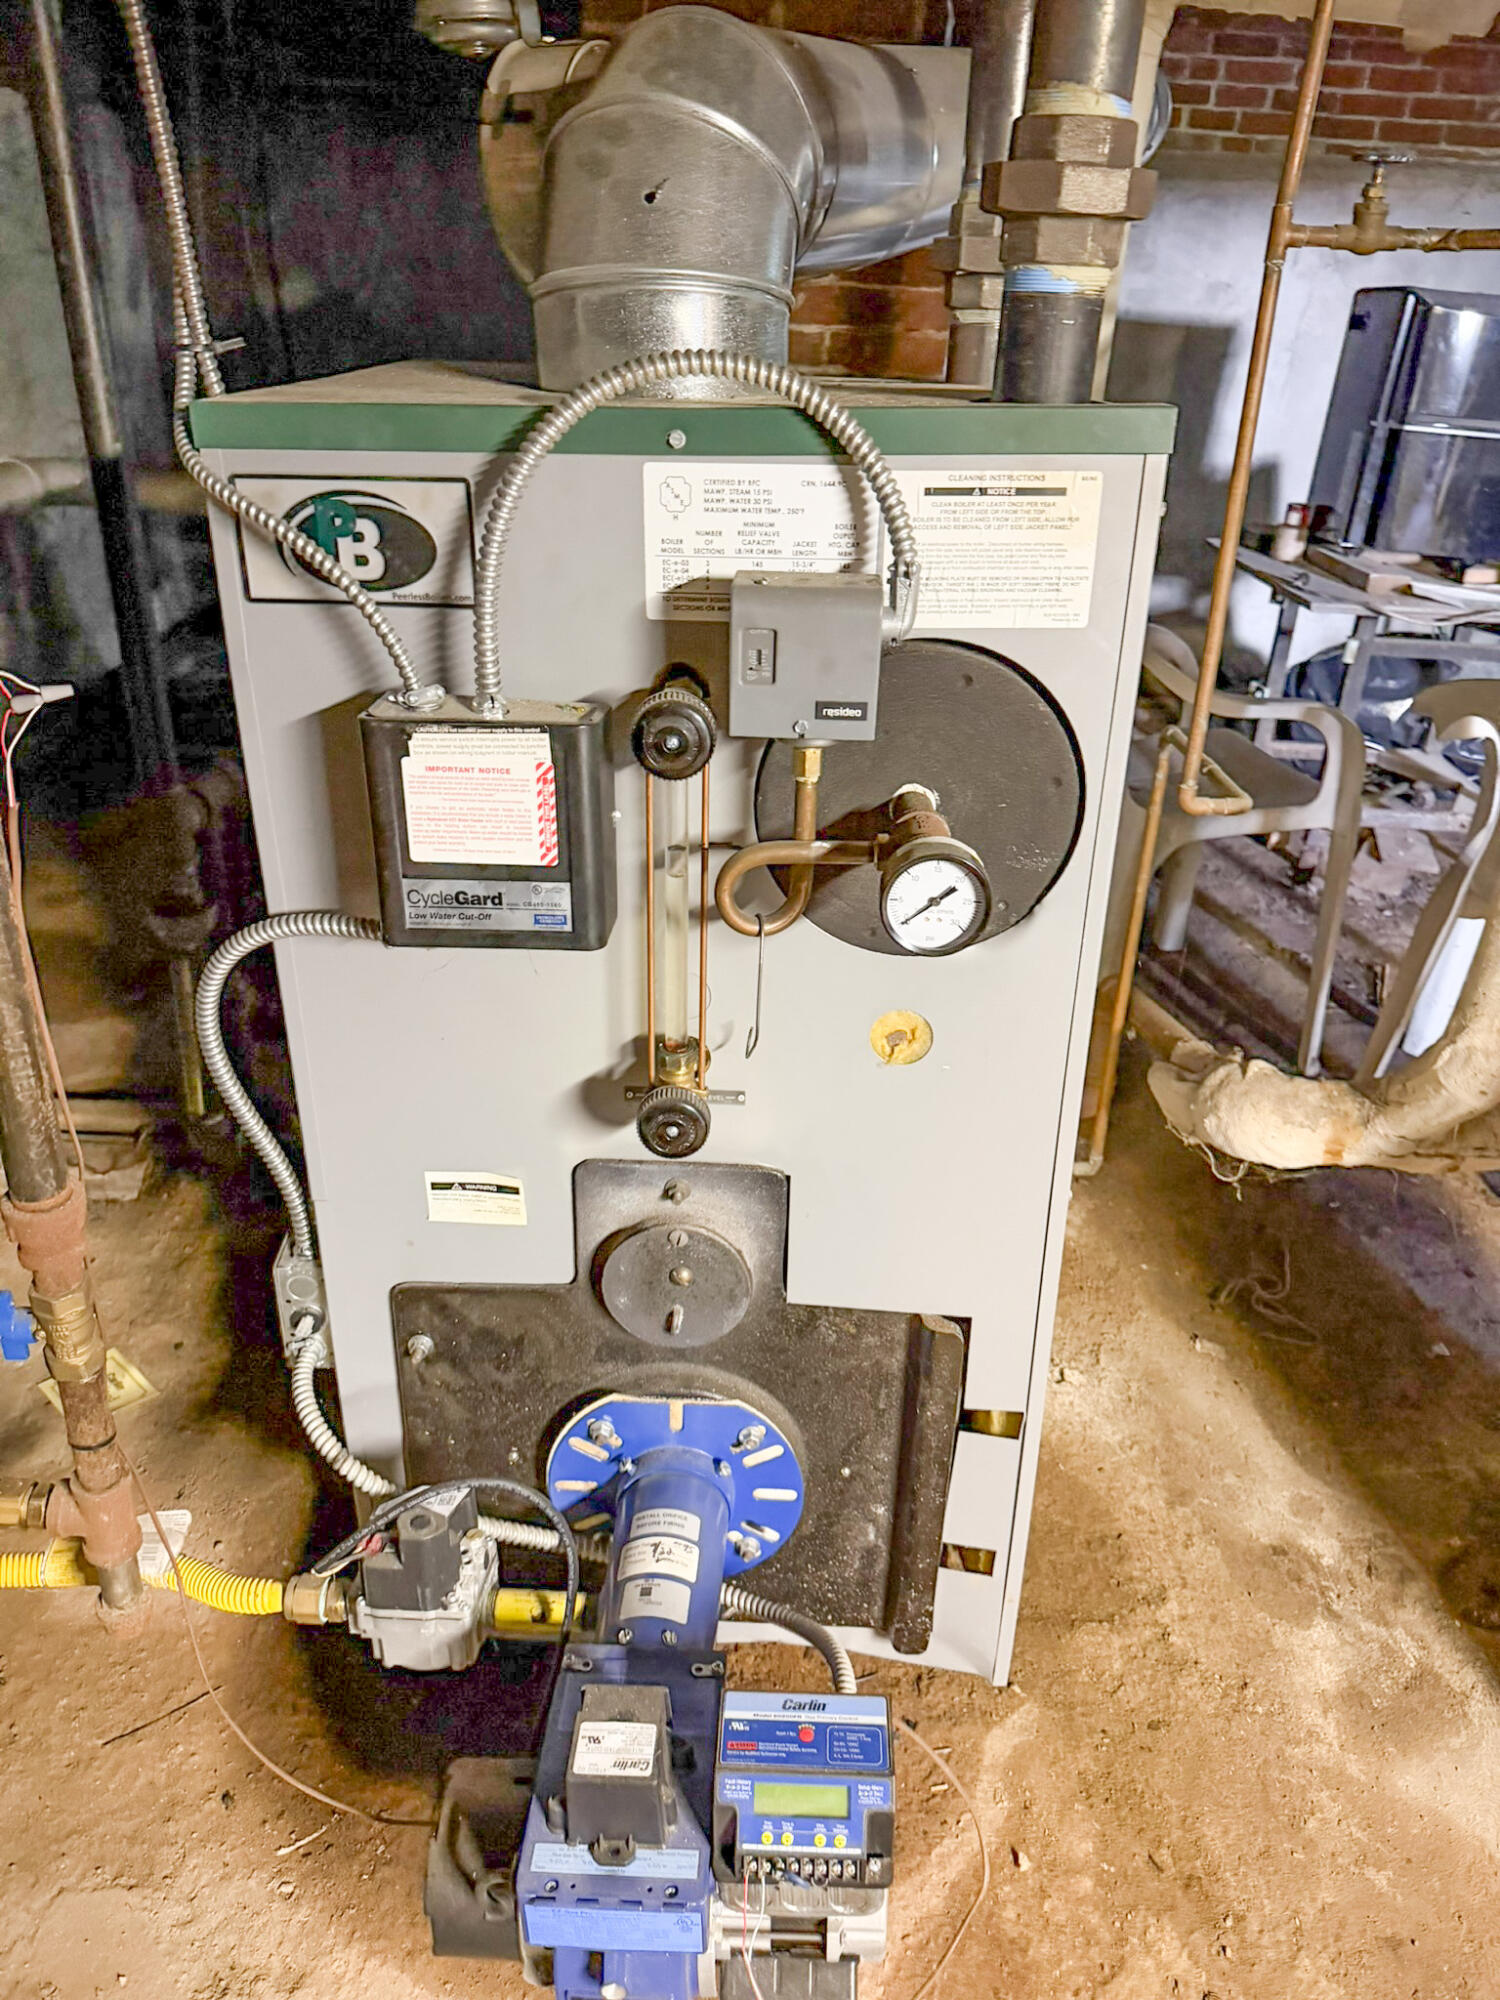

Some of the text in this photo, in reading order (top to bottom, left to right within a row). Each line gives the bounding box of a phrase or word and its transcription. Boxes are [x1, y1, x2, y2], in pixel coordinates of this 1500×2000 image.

[987, 488, 1016, 496] NOTICE
[823, 706, 861, 718] resideo
[425, 765, 511, 775] IMPORTANT NOTICE
[407, 889, 503, 907] CycleGard
[409, 911, 492, 921] Low Water Cut-Off
[465, 1184, 498, 1192] WARNING
[781, 1699, 827, 1712] Carlin
[612, 1760, 650, 1772] Carlin
